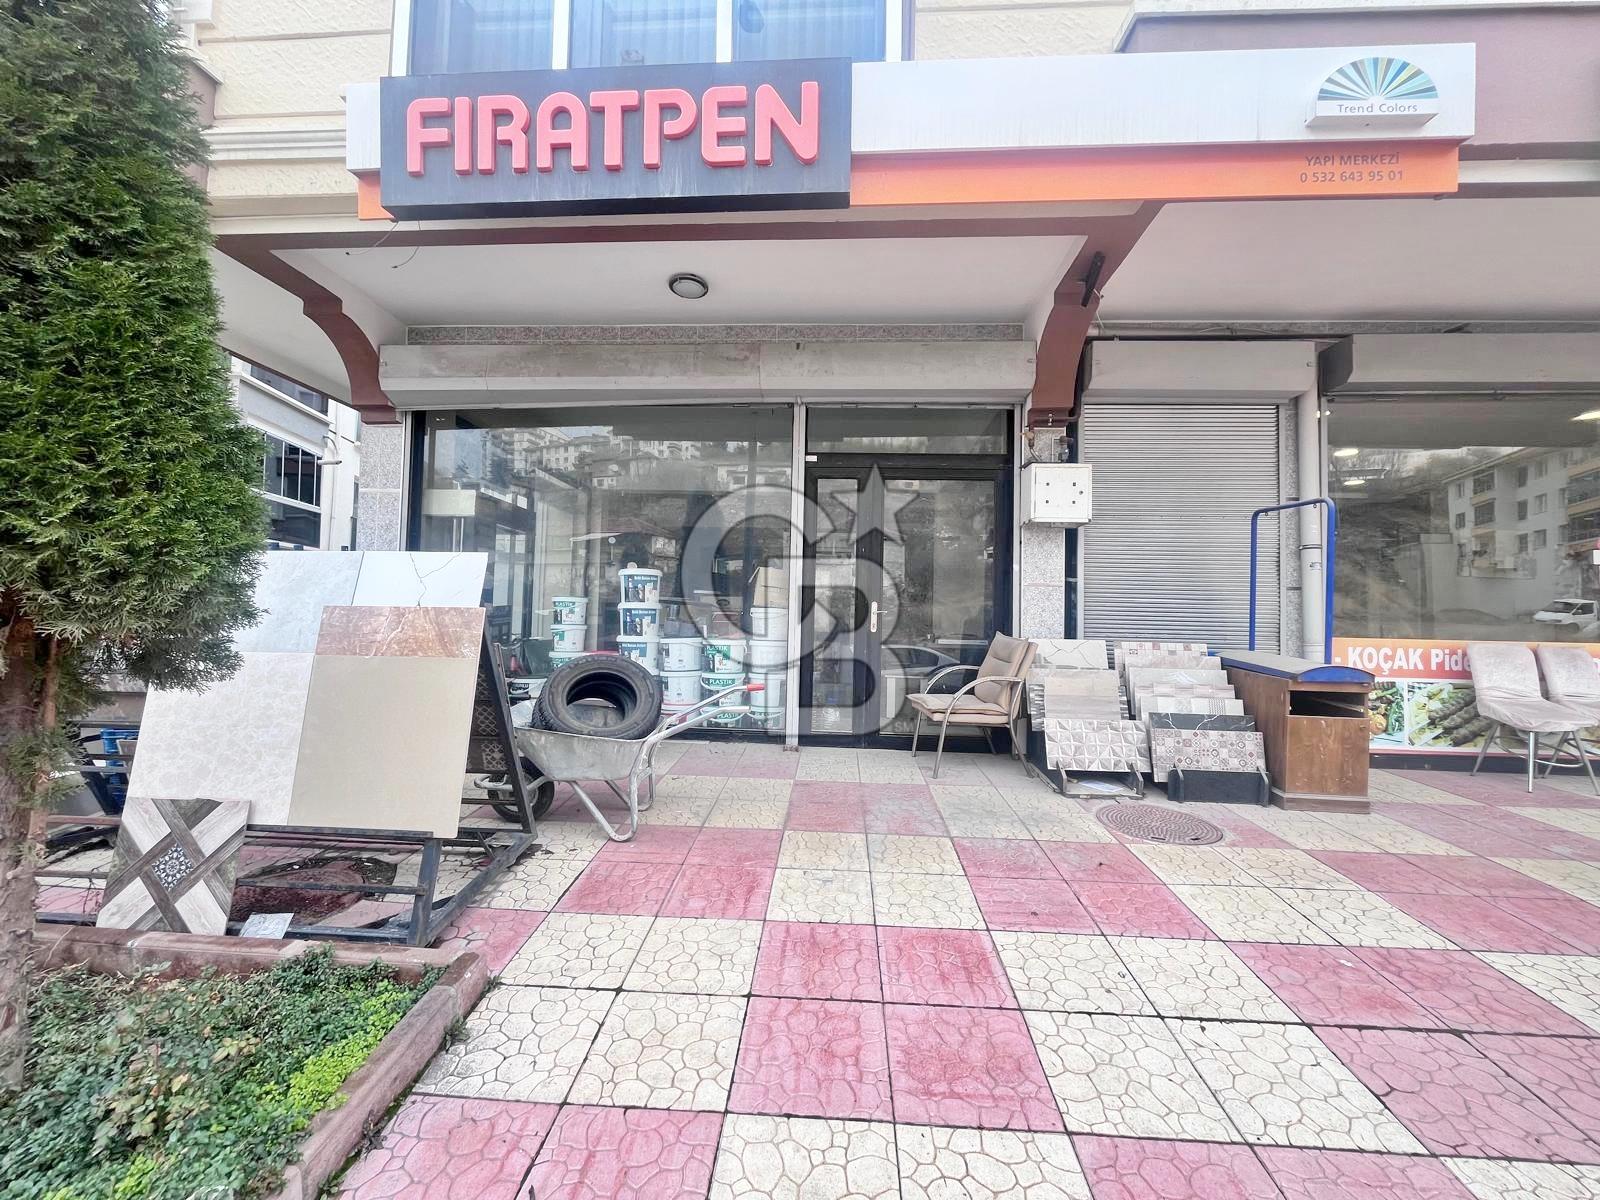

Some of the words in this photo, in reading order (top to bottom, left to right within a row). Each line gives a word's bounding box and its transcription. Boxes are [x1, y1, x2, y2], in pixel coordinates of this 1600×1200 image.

[1337, 104, 1374, 114] Trend
[1379, 102, 1418, 113] Colors
[406, 81, 820, 176] FIRATPEN
[1305, 155, 1335, 167] YAPI
[1300, 172, 1308, 183] 0
[1312, 171, 1336, 183] 532
[1340, 170, 1364, 182] 643
[1368, 170, 1384, 181] 95
[1388, 169, 1403, 181] 01
[1347, 646, 1424, 675] KOÇAK
